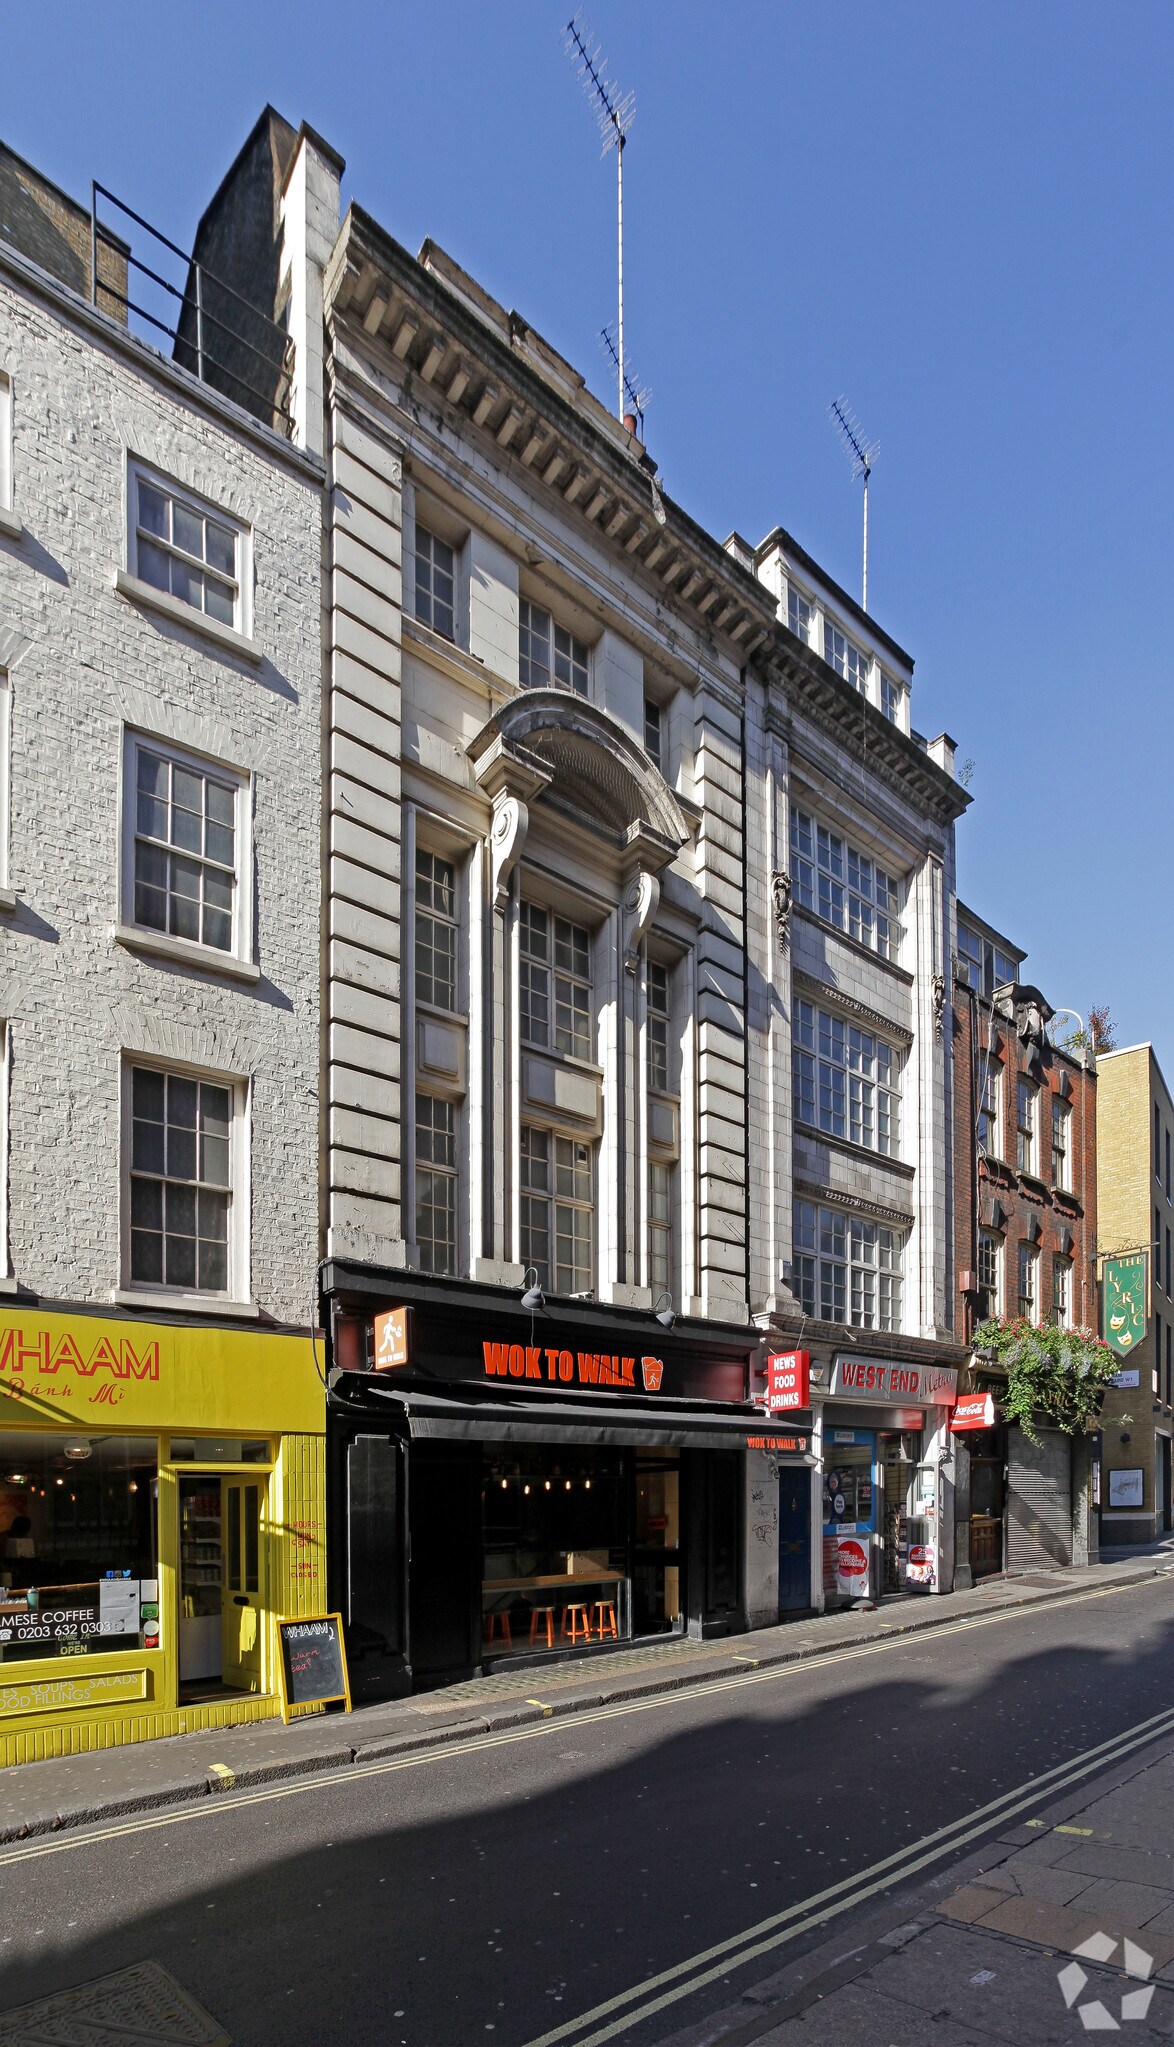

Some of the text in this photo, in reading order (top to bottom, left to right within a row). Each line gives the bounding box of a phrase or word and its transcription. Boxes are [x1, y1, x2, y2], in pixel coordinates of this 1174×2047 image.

[1117, 1256, 1144, 1268] THE
[1108, 1270, 1144, 1326] LYRIC
[483, 1341, 635, 1387] WOK TO WALK
[773, 1355, 796, 1371] NEWS
[774, 1374, 796, 1389] FOOD
[842, 1363, 886, 1389] WEST
[890, 1369, 919, 1393] END
[2, 1377, 73, 1401] Bánh
[770, 1392, 799, 1408] DRINKS
[747, 1437, 796, 1450] WOK TO WALK
[293, 1521, 317, 1529] HOURS
[42, 1609, 94, 1623] COFFEE
[17, 1621, 112, 1640] 0203 632 0303
[282, 1622, 328, 1639] WHAAM
[60, 1644, 88, 1655] OPEN
[30, 1680, 75, 1696] SOUPS
[89, 1674, 138, 1689] SALADS
[35, 1688, 91, 1705] FILLINGS
